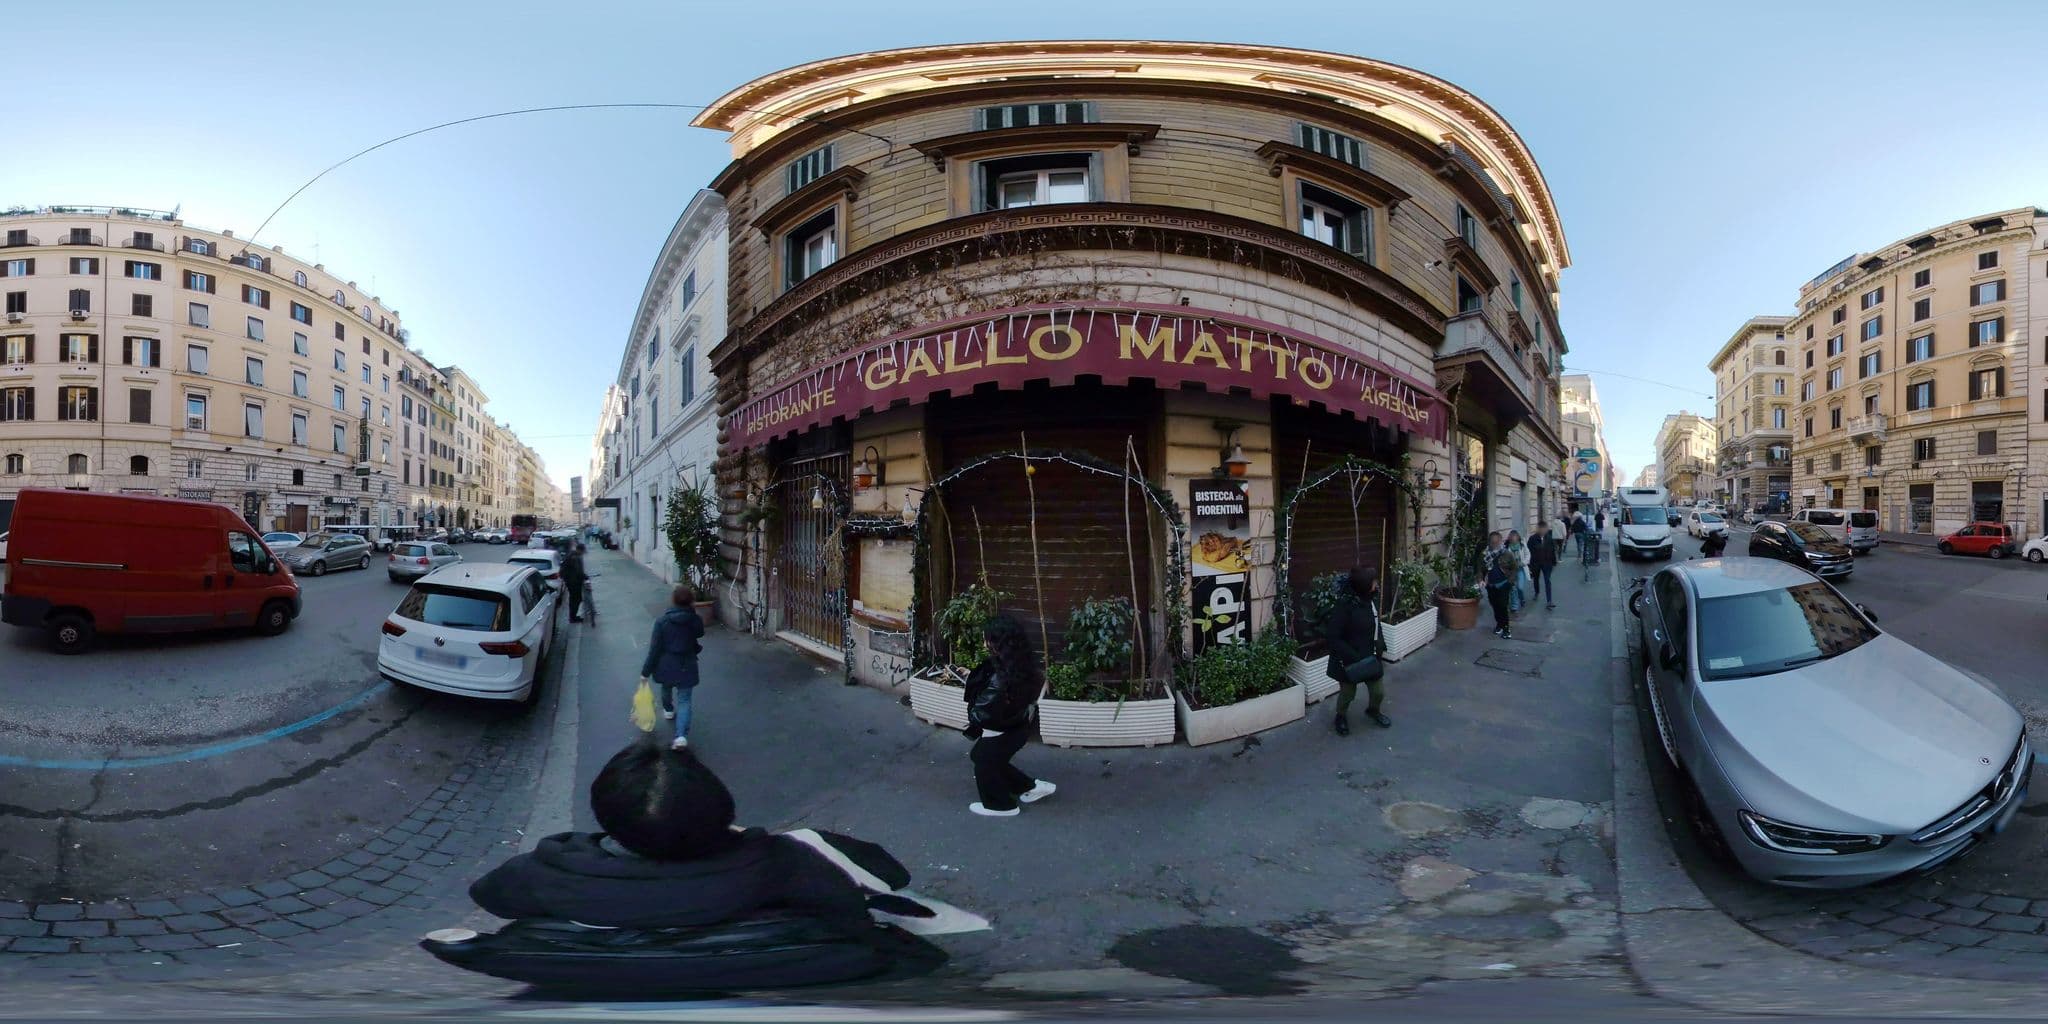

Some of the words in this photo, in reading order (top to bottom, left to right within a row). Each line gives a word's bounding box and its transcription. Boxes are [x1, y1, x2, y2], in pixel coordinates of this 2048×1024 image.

[864, 324, 1083, 392] GALLO
[1118, 324, 1334, 391] MATTO
[746, 388, 836, 436] RISTORANTE
[1195, 491, 1234, 502] BISTECCA
[1196, 504, 1244, 516] FIORENTINA
